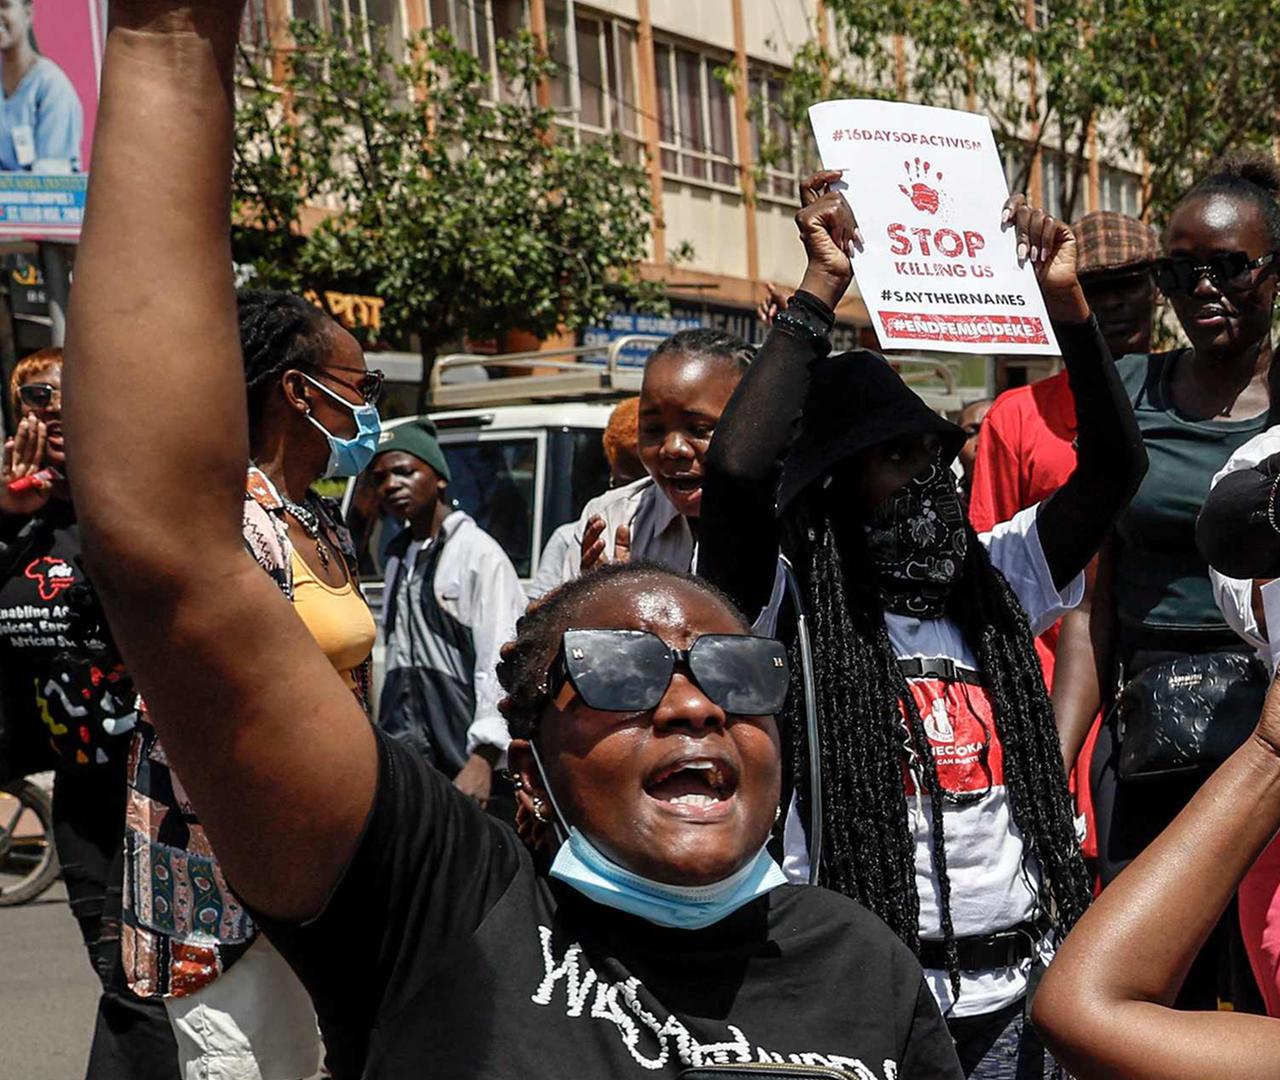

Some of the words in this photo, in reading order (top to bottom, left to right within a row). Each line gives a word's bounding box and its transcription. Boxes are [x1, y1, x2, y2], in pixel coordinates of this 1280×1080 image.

[832, 128, 982, 151] #16DAYSOFACTIVISM
[887, 222, 986, 258] STOP
[895, 261, 967, 278] KILLING
[971, 265, 995, 278] US
[881, 289, 1026, 306] #SAYTHEIRNAMES
[892, 317, 1035, 337] #ENDFEMICIDEKE
